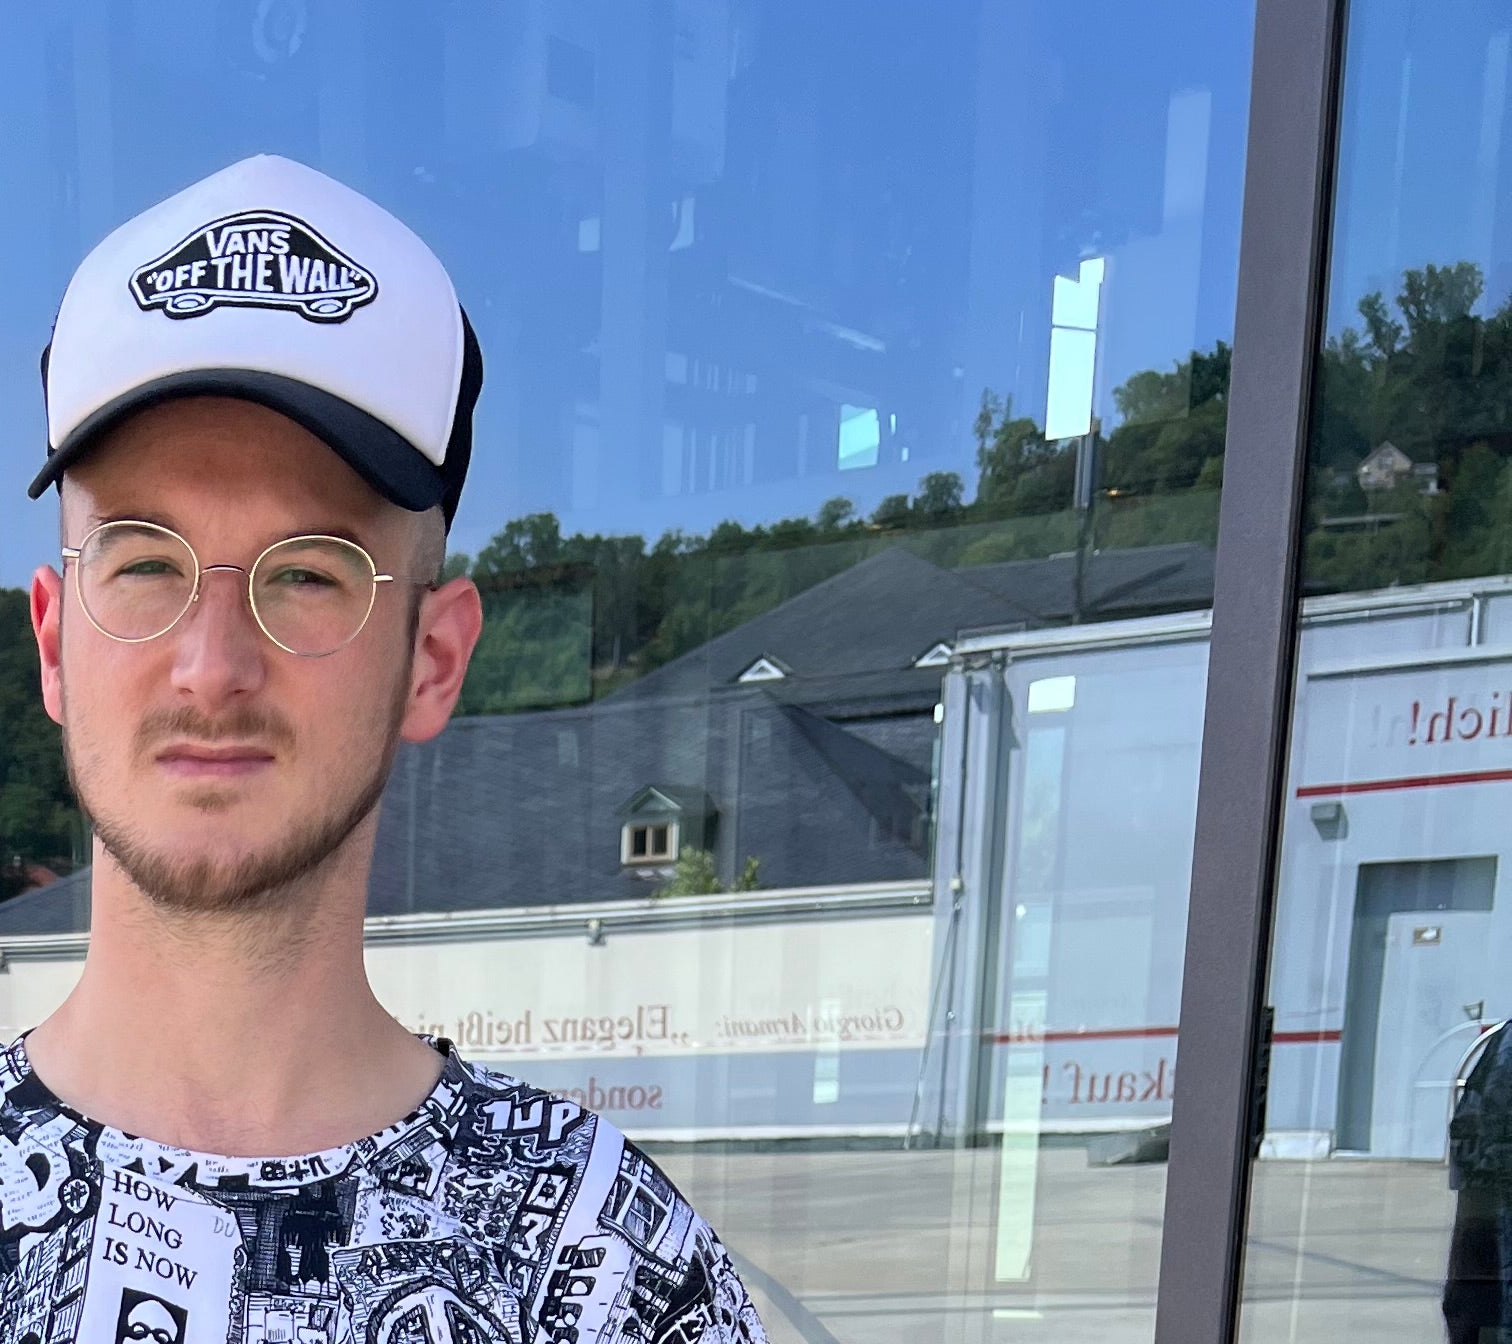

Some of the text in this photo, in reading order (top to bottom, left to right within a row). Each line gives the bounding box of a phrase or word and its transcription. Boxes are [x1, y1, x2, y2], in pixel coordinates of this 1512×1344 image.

[205, 224, 292, 257] VANS
[211, 255, 274, 292] THE
[113, 1170, 177, 1212] HOW
[108, 1202, 183, 1249] LONG
[103, 1237, 198, 1290] IS NOW
